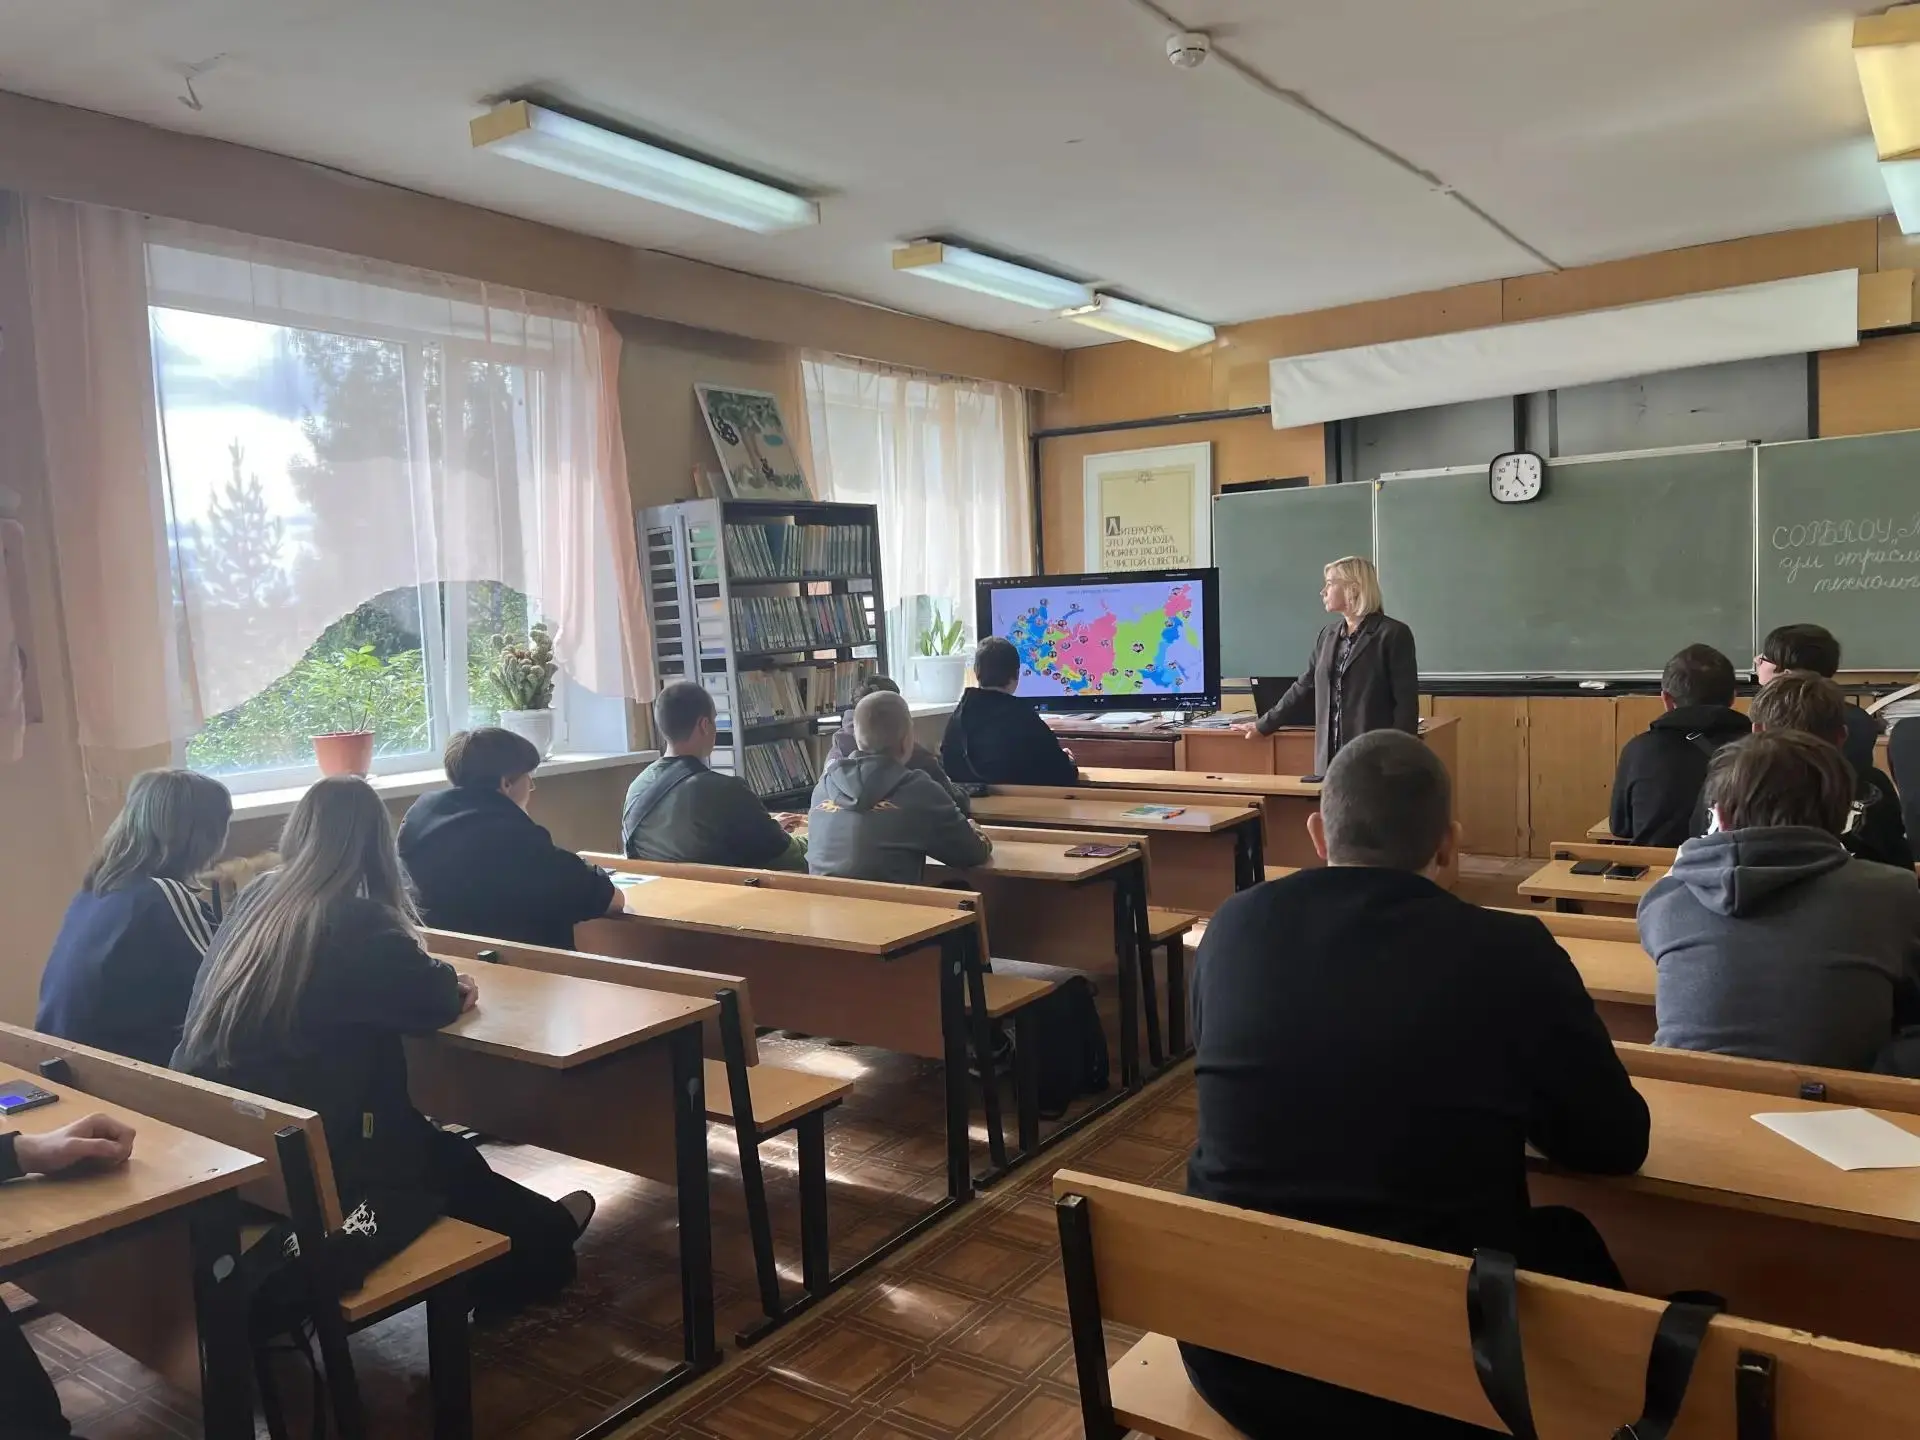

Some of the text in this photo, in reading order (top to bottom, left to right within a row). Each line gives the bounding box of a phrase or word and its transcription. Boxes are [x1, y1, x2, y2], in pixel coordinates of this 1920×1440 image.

[1106, 539, 1123, 547] ЭТО
[1153, 535, 1174, 544] КУДА
[1106, 547, 1138, 558] МОЖНО
[1114, 557, 1147, 567] ЧИСТОЙ
